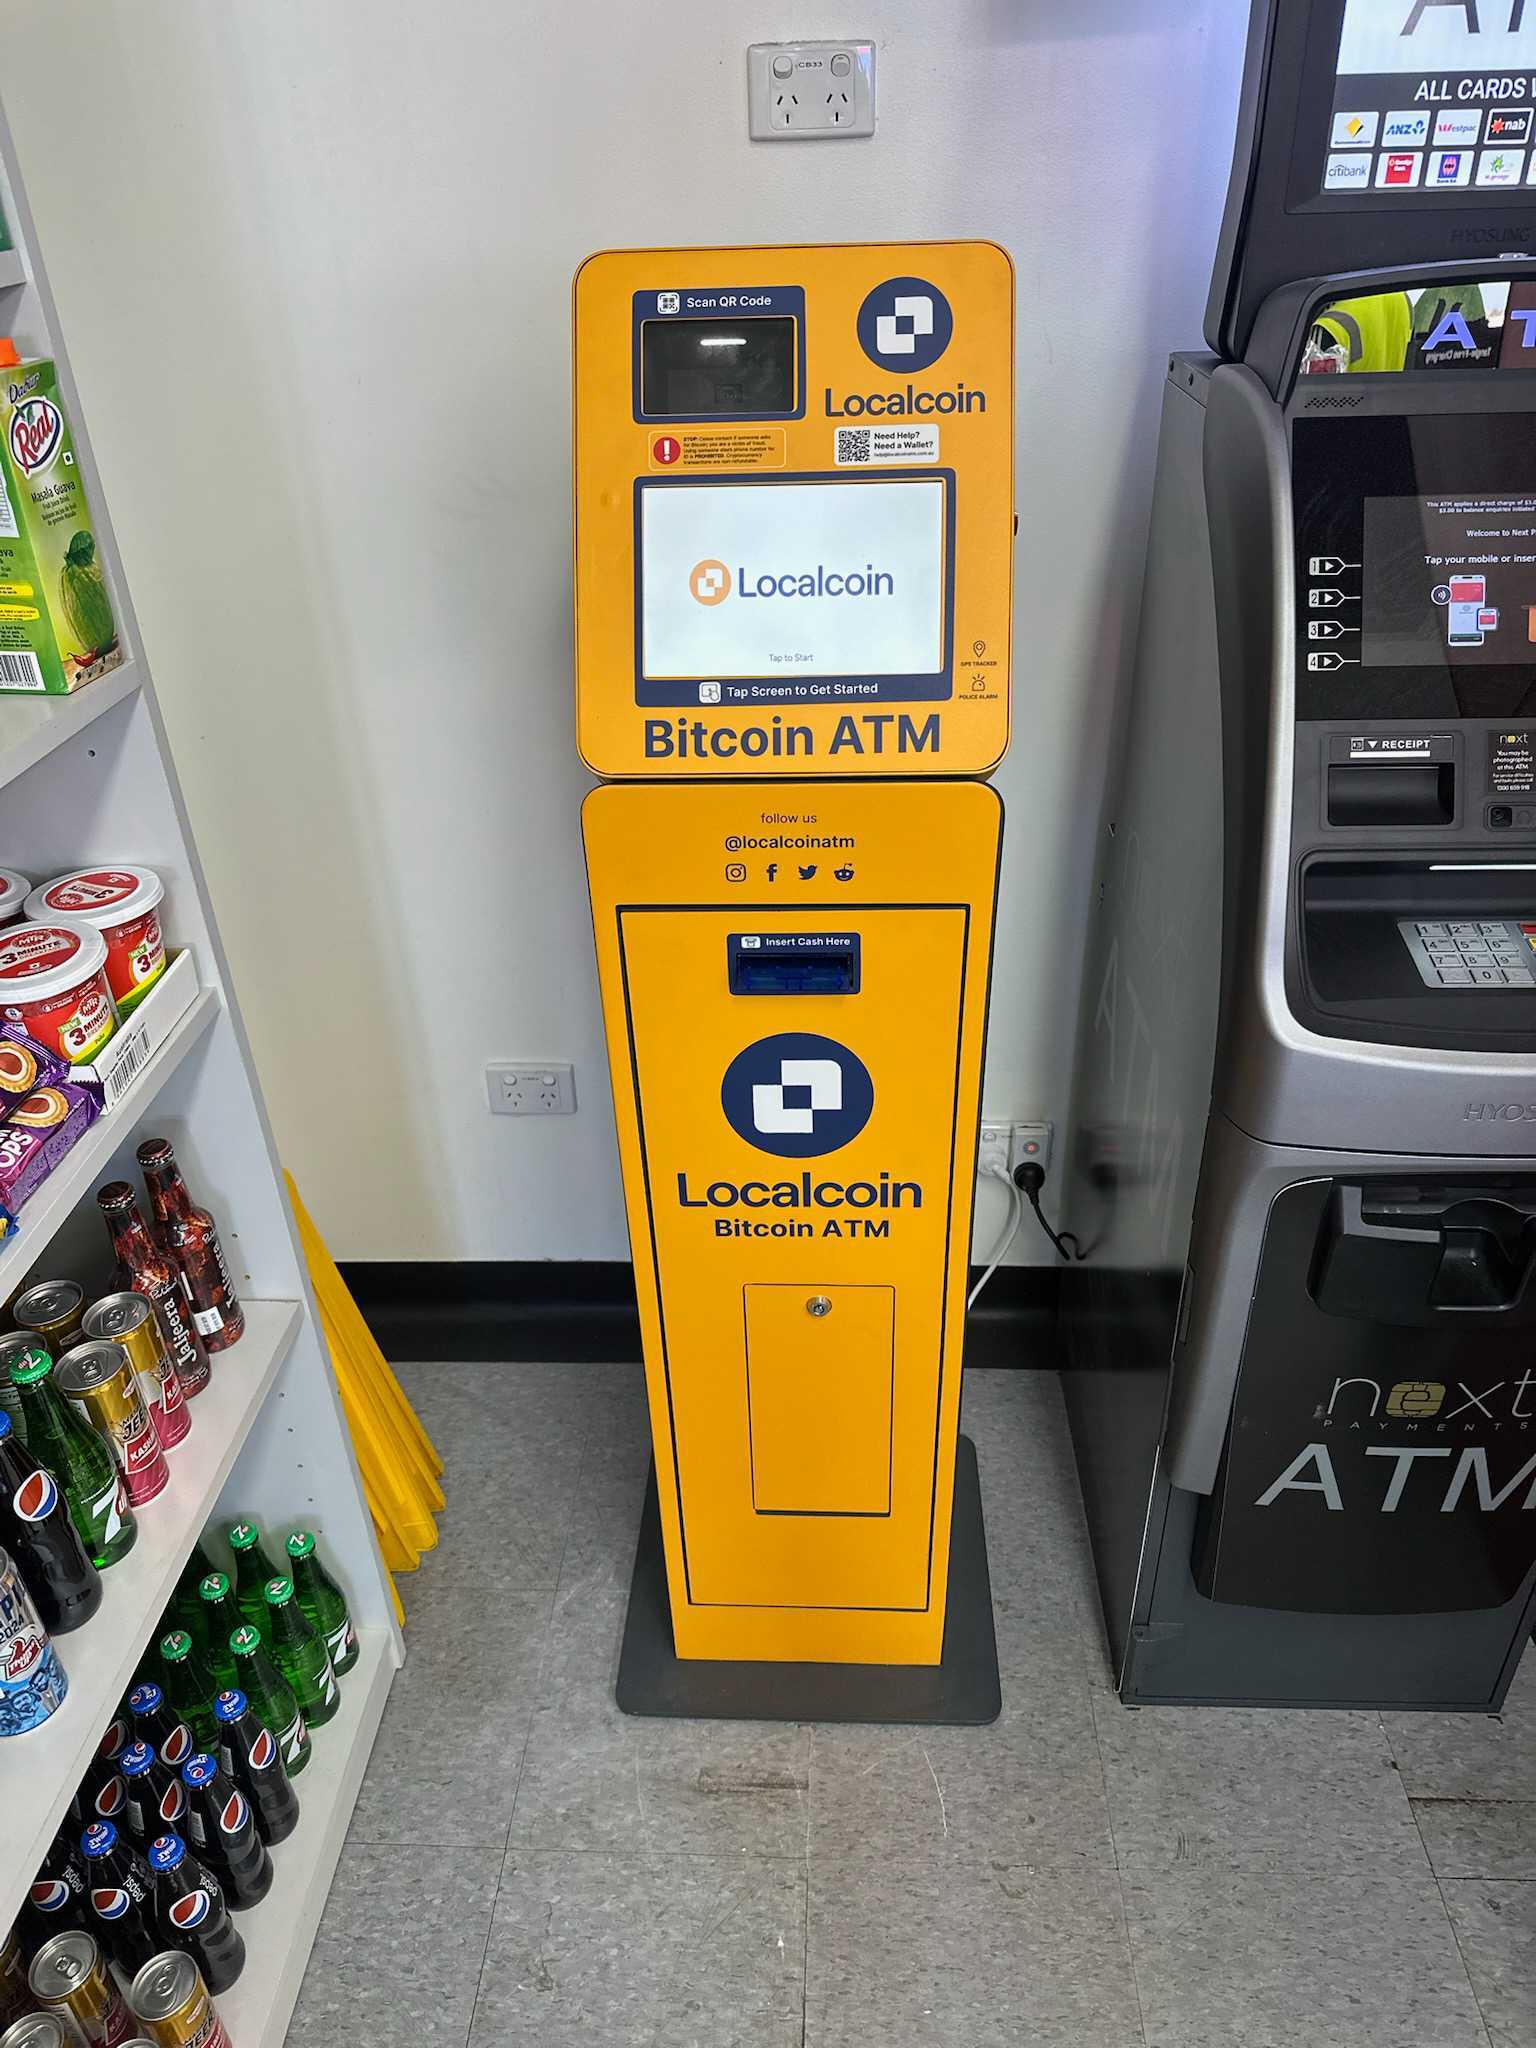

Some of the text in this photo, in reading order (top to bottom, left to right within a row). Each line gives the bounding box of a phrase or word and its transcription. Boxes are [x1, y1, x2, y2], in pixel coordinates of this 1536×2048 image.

[1414, 79, 1452, 101] ALL
[1457, 77, 1527, 100] CARDS
[1386, 124, 1411, 135] ANZ
[1504, 118, 1526, 131] nab
[1328, 164, 1367, 177] citibank
[686, 296, 772, 308] Scan QR Code
[825, 383, 986, 417] Localcoin
[15, 400, 54, 475] Real
[897, 431, 920, 441] Help?
[874, 441, 895, 450] Need
[904, 440, 934, 449] Wallet?
[31, 484, 53, 503] Masala
[54, 479, 76, 496] Guava
[1466, 529, 1500, 537] Welcome
[1424, 555, 1442, 565] Tap
[1444, 556, 1466, 565] your
[1468, 554, 1499, 563] mobile
[738, 564, 894, 598] Localcoin
[769, 653, 814, 663] Tap to Start
[727, 683, 878, 698] Tap Screen to Get Started
[644, 714, 941, 758] Bitcoin ATM
[1381, 739, 1431, 749] RECEIPT
[761, 813, 817, 823] follow us
[725, 834, 855, 851] @localcoinatm
[766, 937, 850, 946] Insert Cash Here
[0, 953, 18, 964] 3
[136, 954, 151, 972] 3
[82, 998, 100, 1015] MTR
[69, 1027, 87, 1046] 3
[677, 1172, 922, 1208] Localcoin
[714, 1219, 889, 1238] Bitcoin ATM
[164, 1297, 197, 1367] Jaljeera
[1327, 1369, 1536, 1419] next
[1322, 1418, 1529, 1432] PAYMENTS
[1254, 1443, 1536, 1512] ATM
[123, 1874, 146, 1902] pepsi
